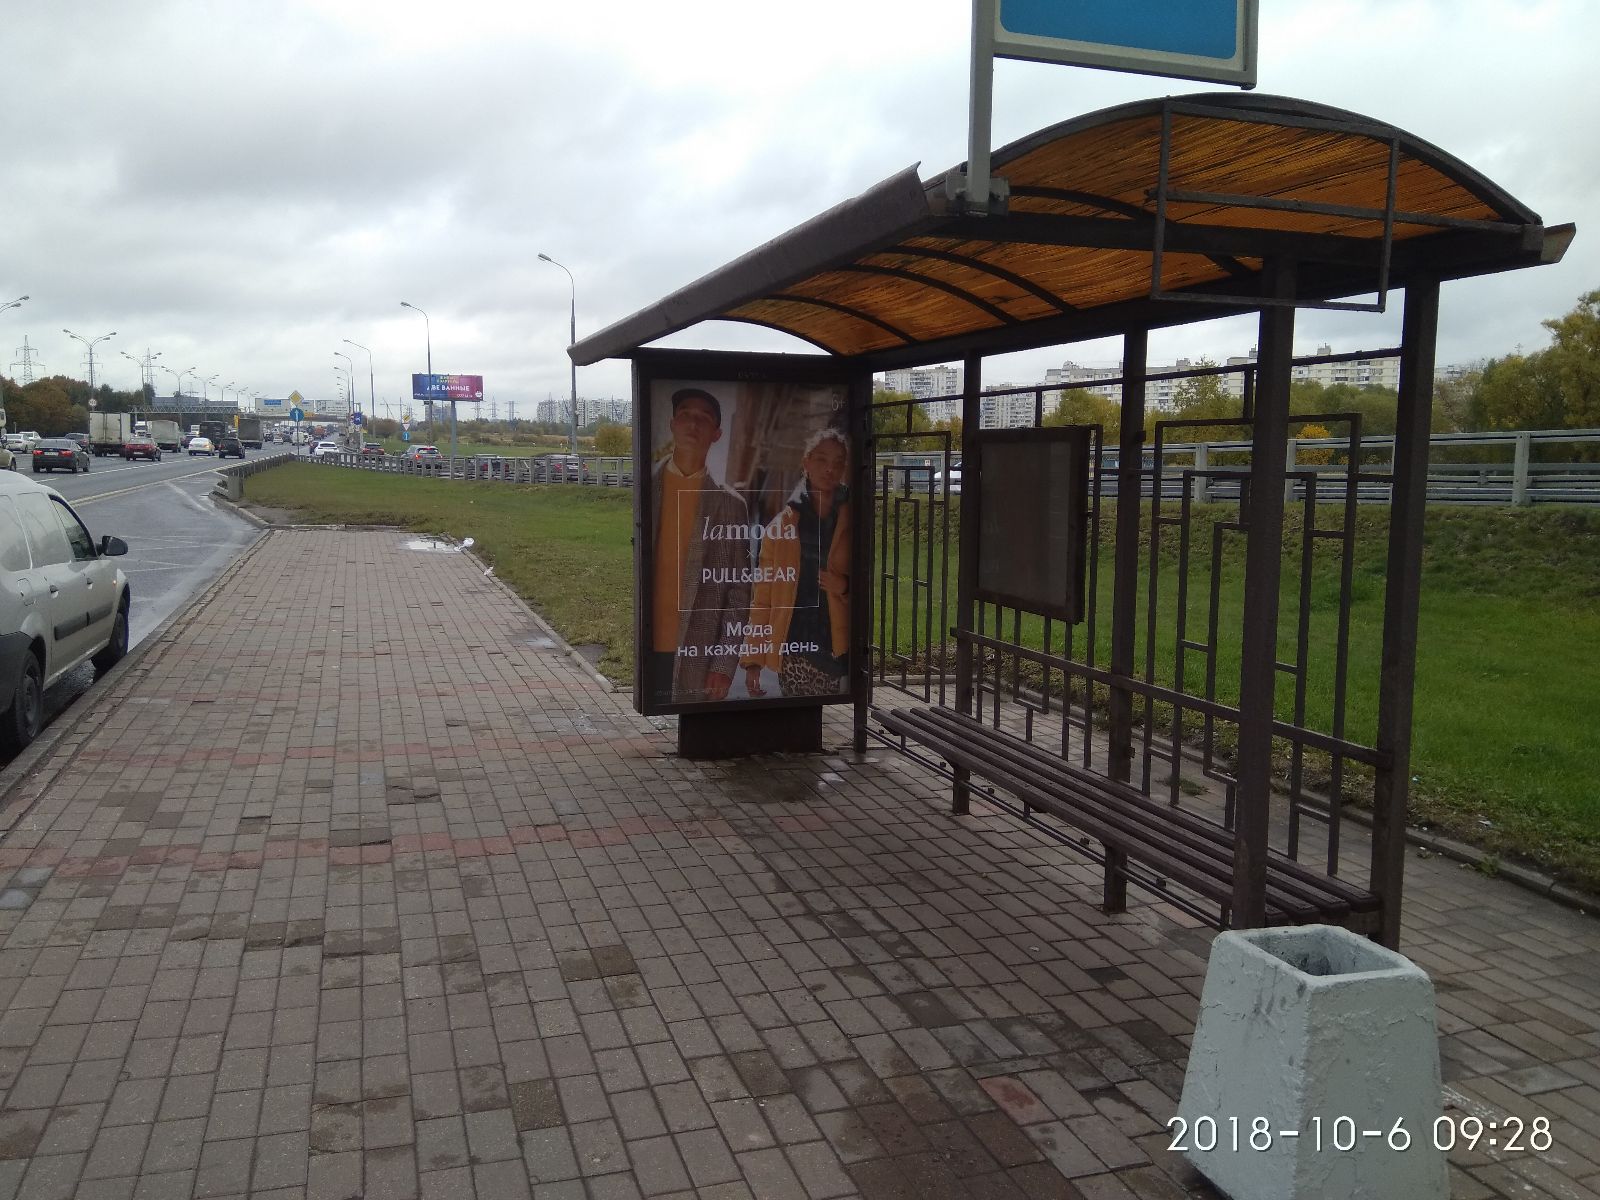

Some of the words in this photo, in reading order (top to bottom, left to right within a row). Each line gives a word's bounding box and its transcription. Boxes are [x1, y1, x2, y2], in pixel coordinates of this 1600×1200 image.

[832, 394, 846, 411] 6+
[702, 516, 798, 541] lamoda
[702, 567, 797, 584] PULL&BEAR
[726, 621, 773, 637] Мода
[677, 645, 698, 657] на
[704, 640, 773, 657] каждый
[778, 640, 820, 655] день
